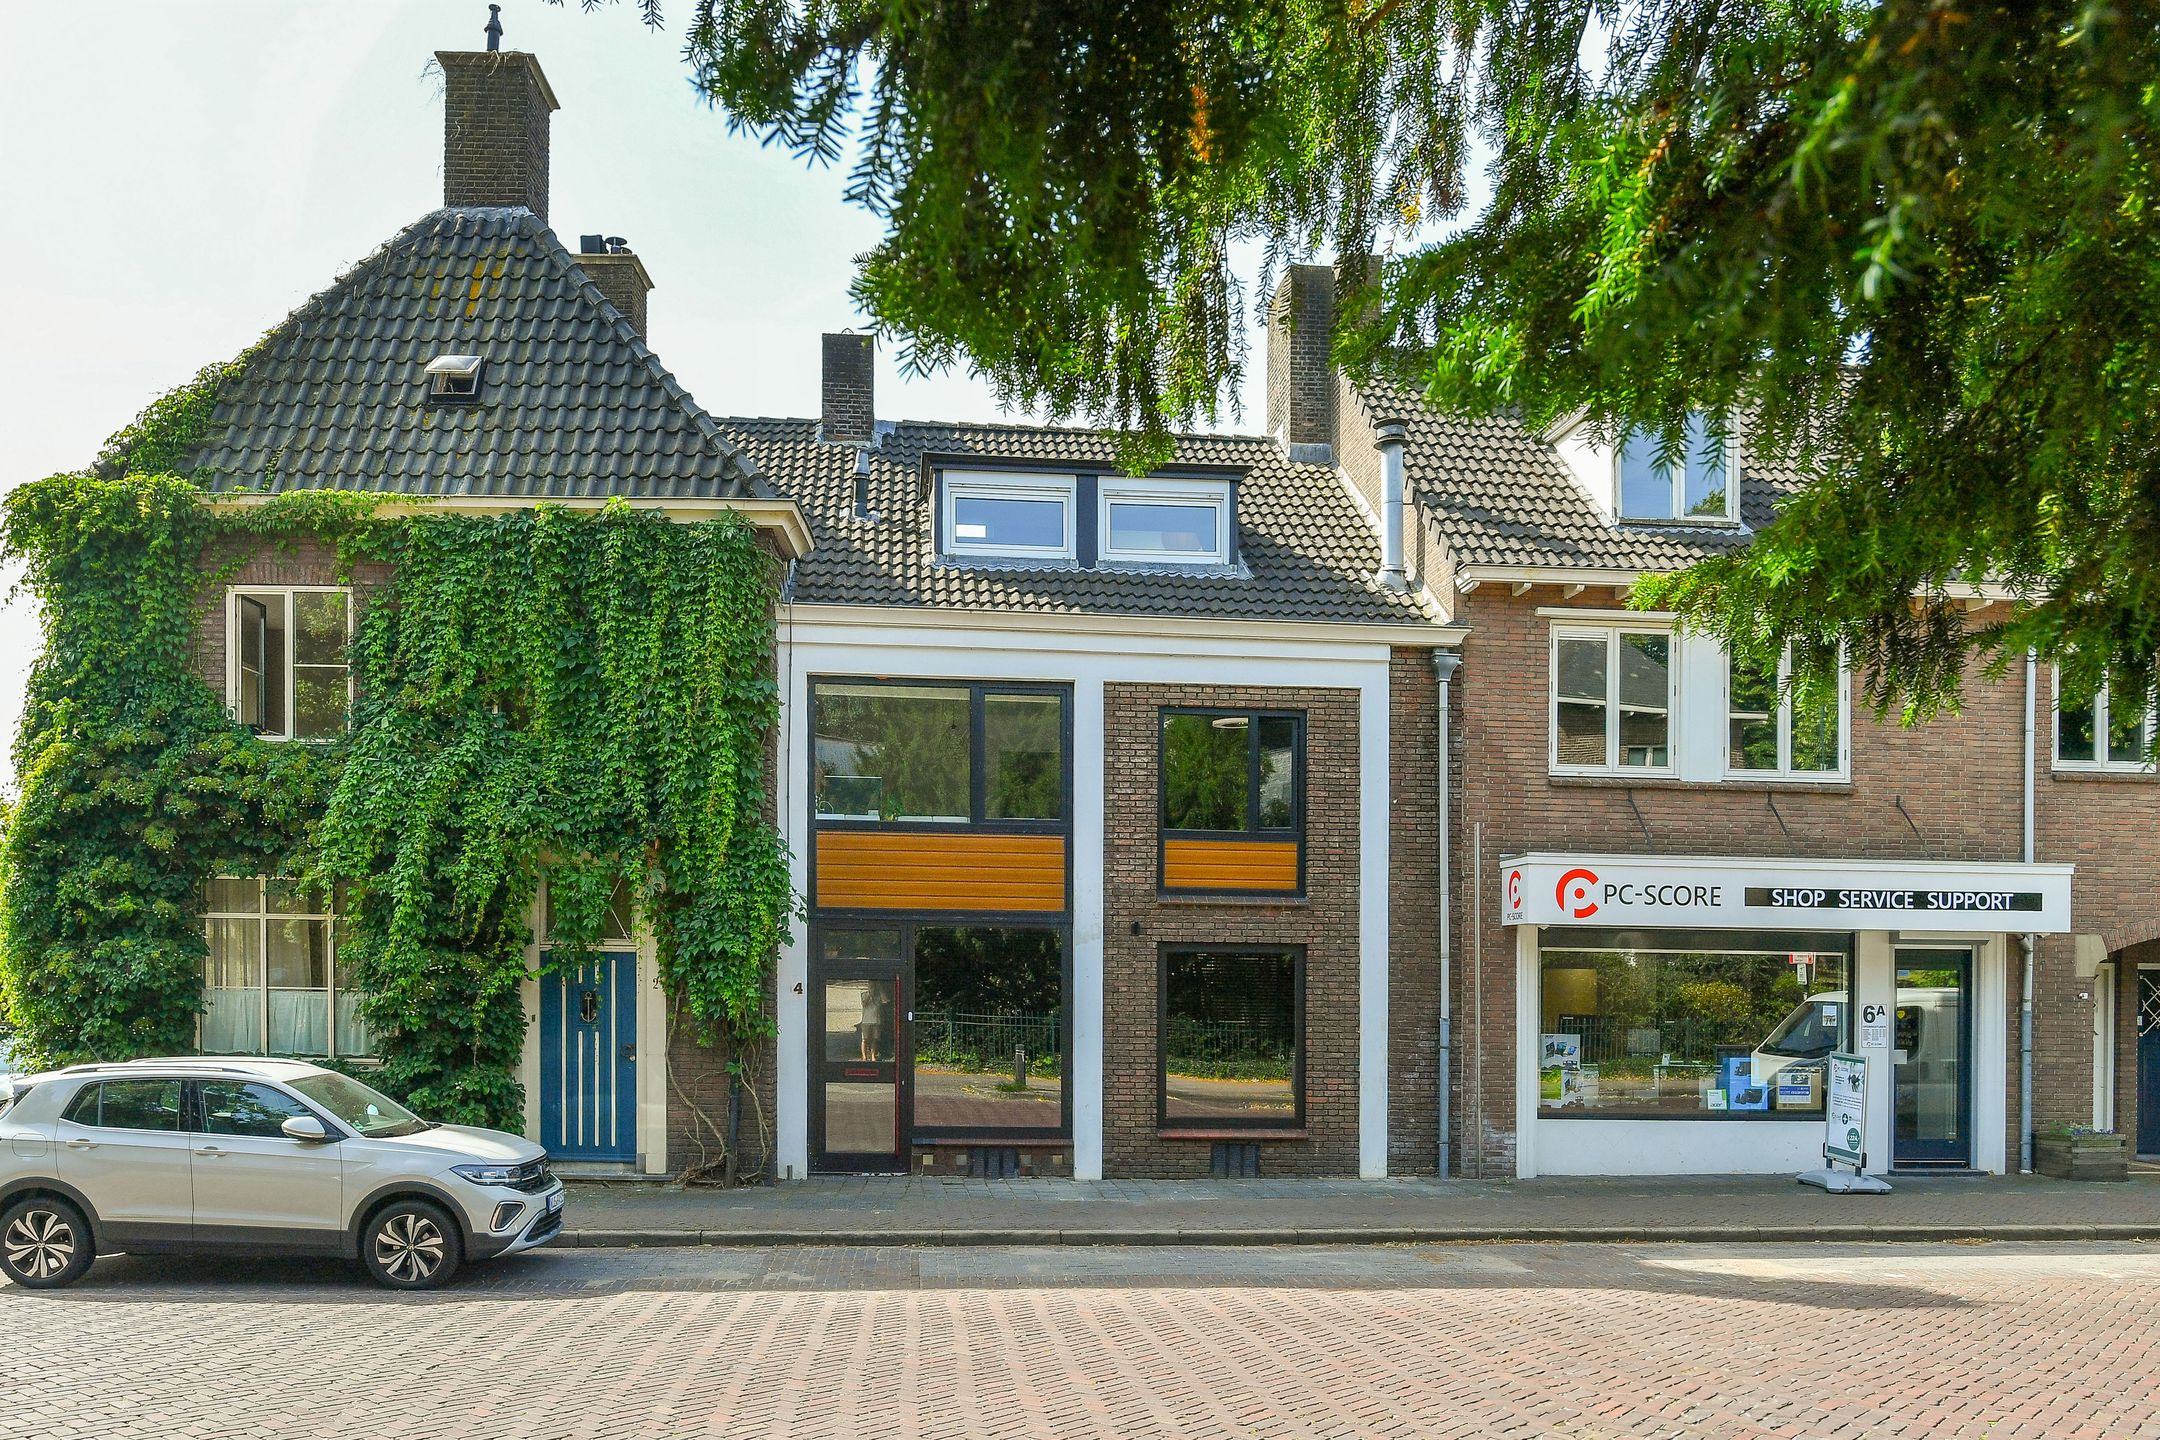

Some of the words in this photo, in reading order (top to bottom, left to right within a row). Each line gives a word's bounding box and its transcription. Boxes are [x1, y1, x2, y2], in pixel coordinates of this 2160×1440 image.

[1604, 884, 1722, 907] PC-SCORE
[1771, 889, 1826, 907] SHOP
[1838, 891, 1914, 909] SERVICE
[1927, 892, 2014, 910] SUPPORT
[1506, 912, 1523, 921] PC-SCORE
[652, 977, 659, 990] 2
[793, 982, 804, 995] 4
[1863, 1005, 1886, 1024] 6A
